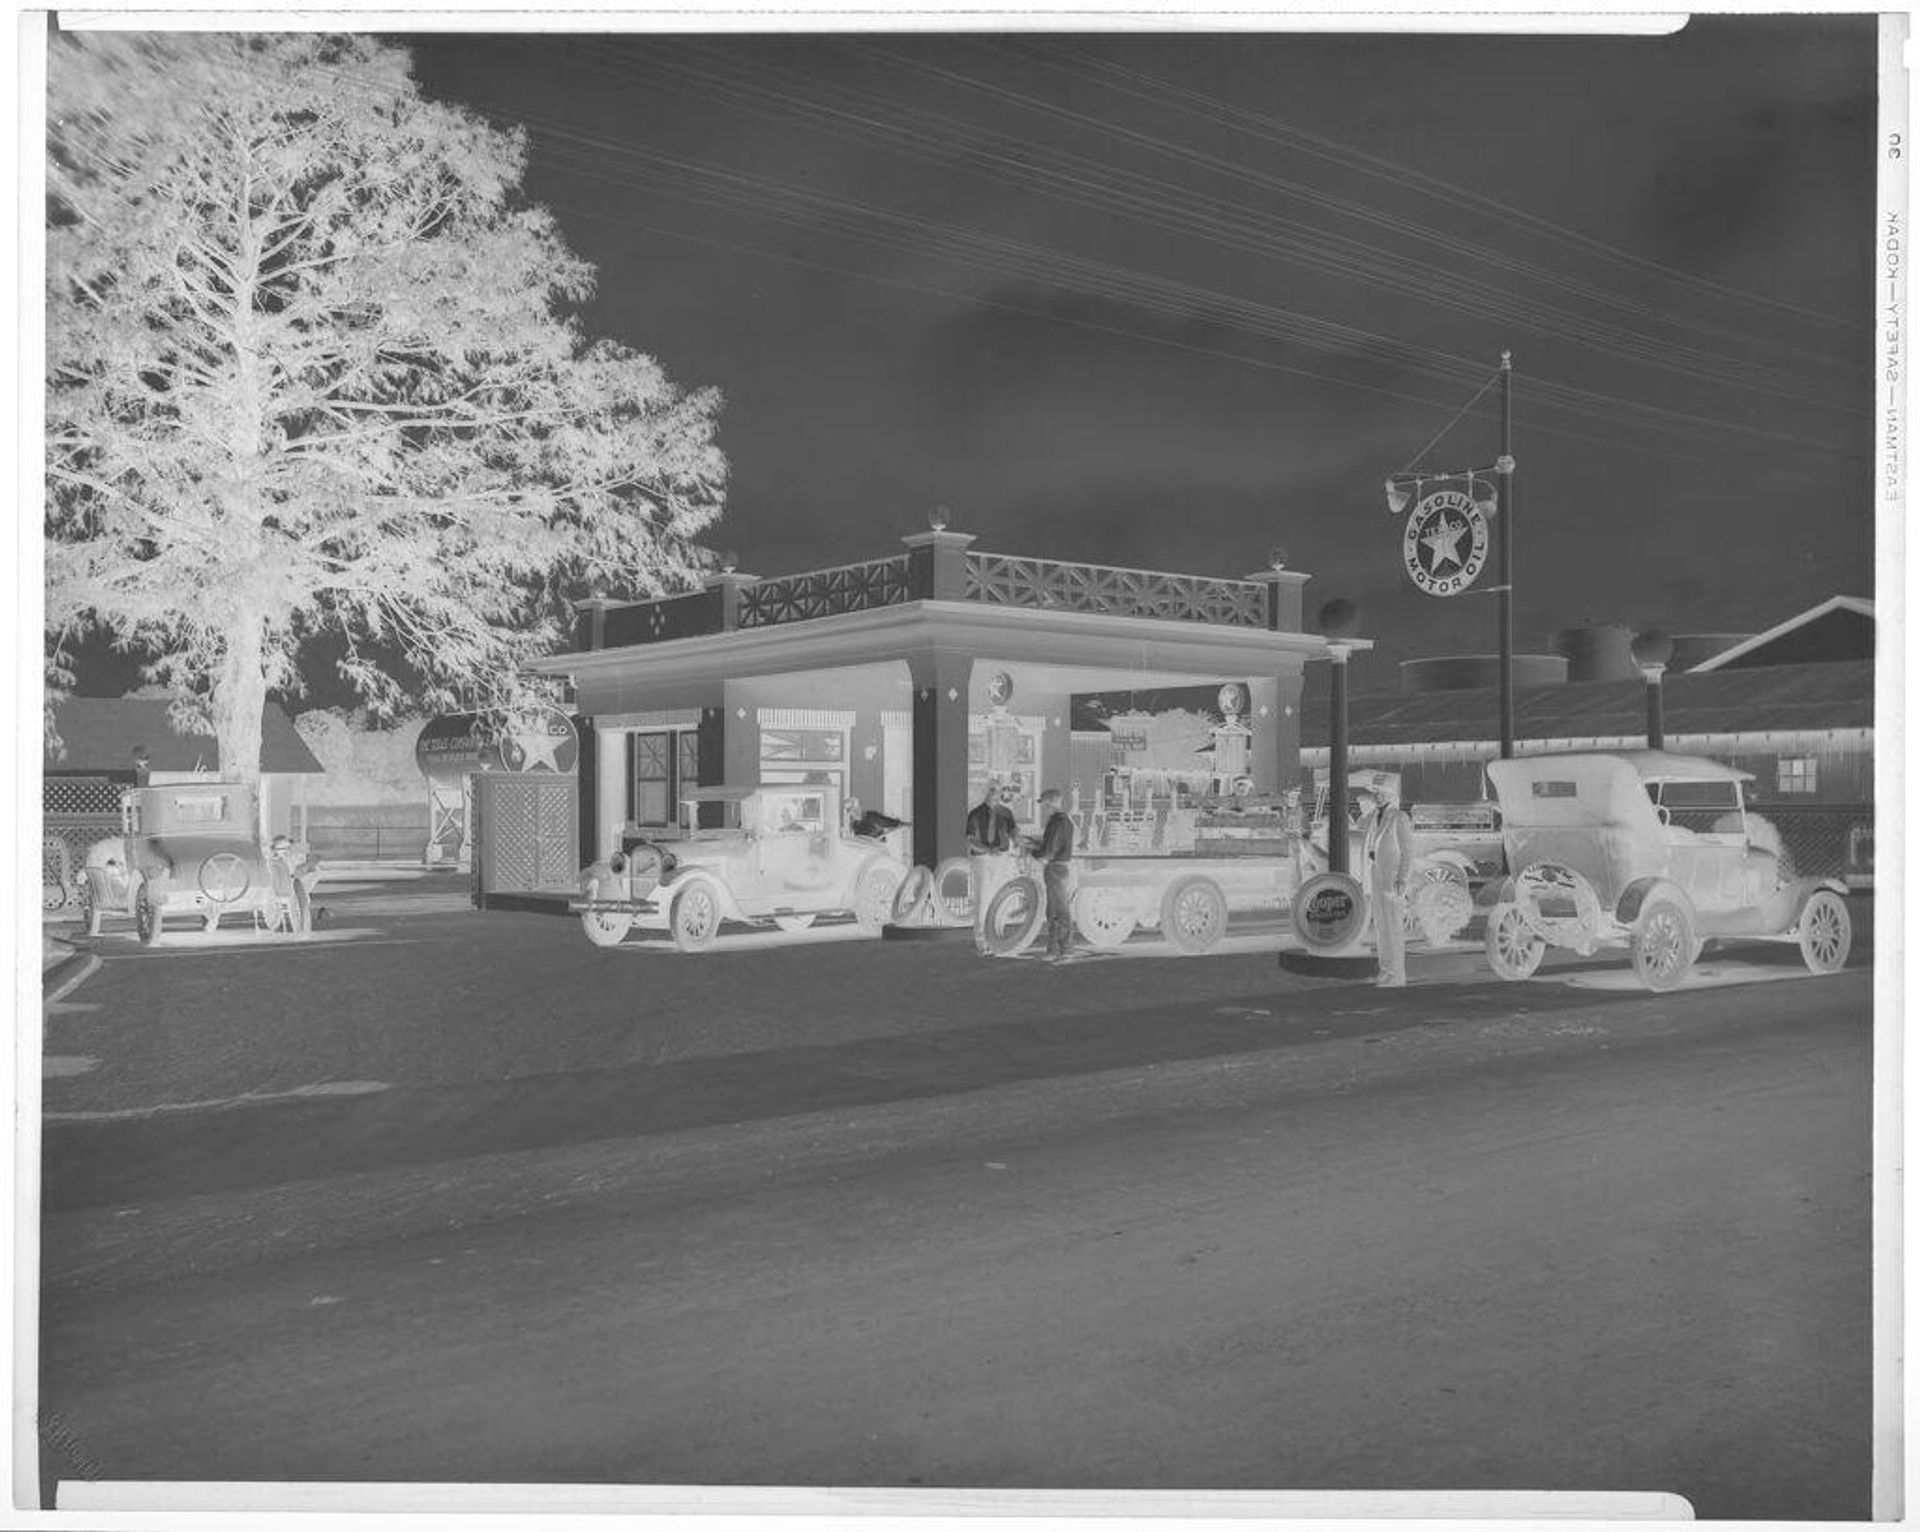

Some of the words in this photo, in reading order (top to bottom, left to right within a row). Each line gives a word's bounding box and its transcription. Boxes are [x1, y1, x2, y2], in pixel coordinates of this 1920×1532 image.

[1408, 495, 1481, 540] GASOLINE
[1408, 557, 1462, 592] MOTOR
[1466, 542, 1485, 575] OIL
